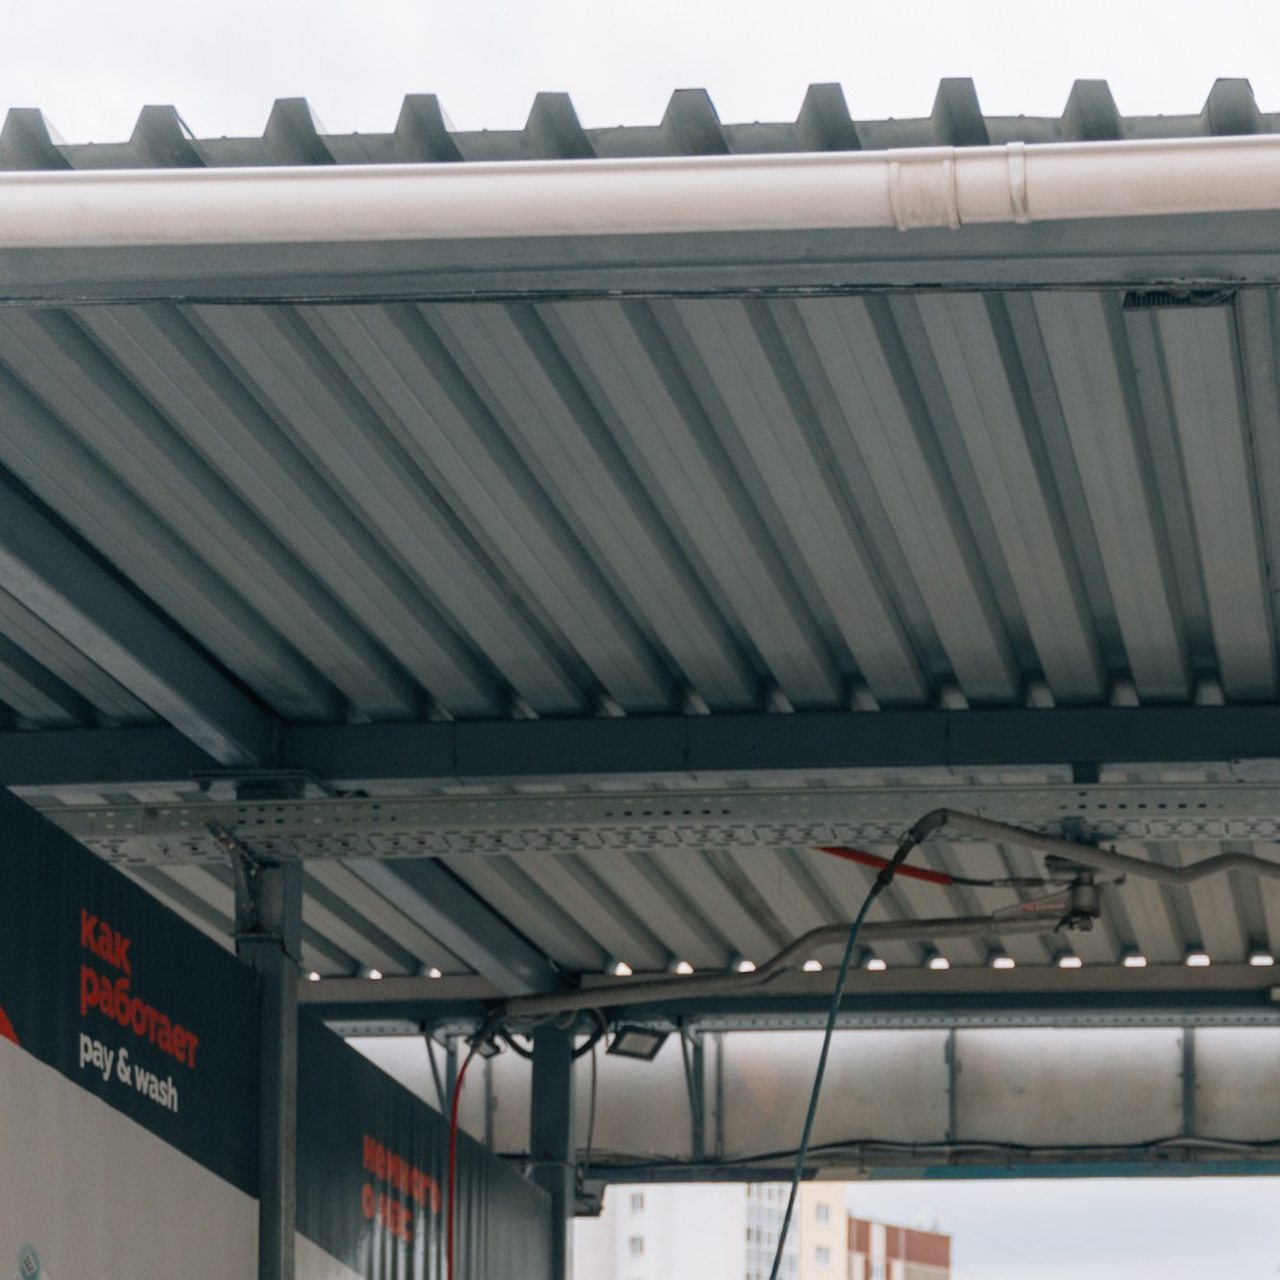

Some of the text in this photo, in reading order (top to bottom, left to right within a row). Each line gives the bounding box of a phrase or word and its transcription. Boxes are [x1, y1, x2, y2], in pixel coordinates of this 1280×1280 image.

[80, 908, 132, 976] как
[80, 963, 200, 1068] работает
[79, 1032, 179, 1112] pay & wash
